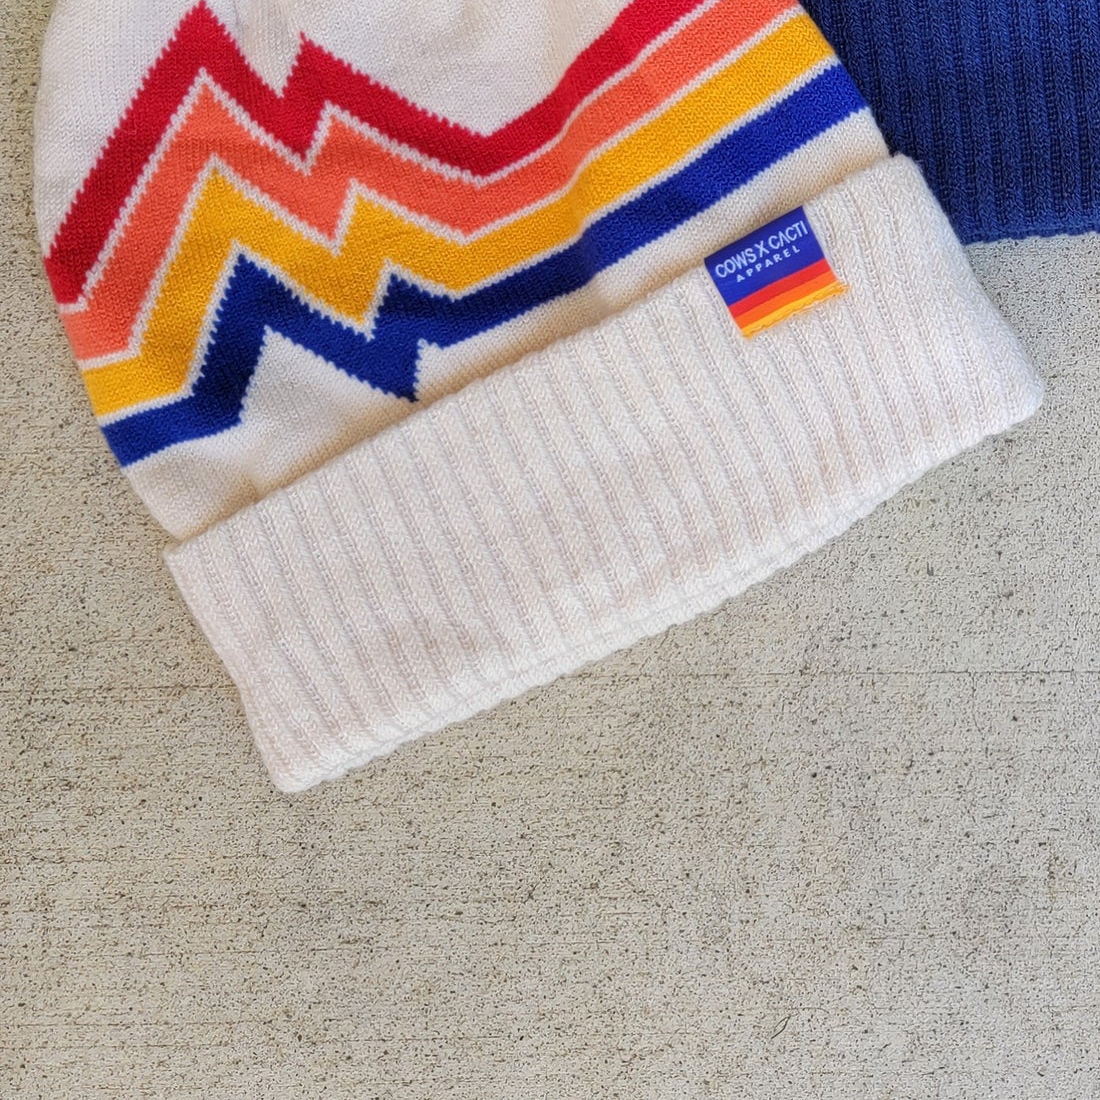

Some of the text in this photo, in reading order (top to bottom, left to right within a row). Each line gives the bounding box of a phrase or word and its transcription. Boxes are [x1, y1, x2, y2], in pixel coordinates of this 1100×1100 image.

[715, 220, 808, 278] COWS X CACTI
[736, 245, 800, 283] APPAREL
